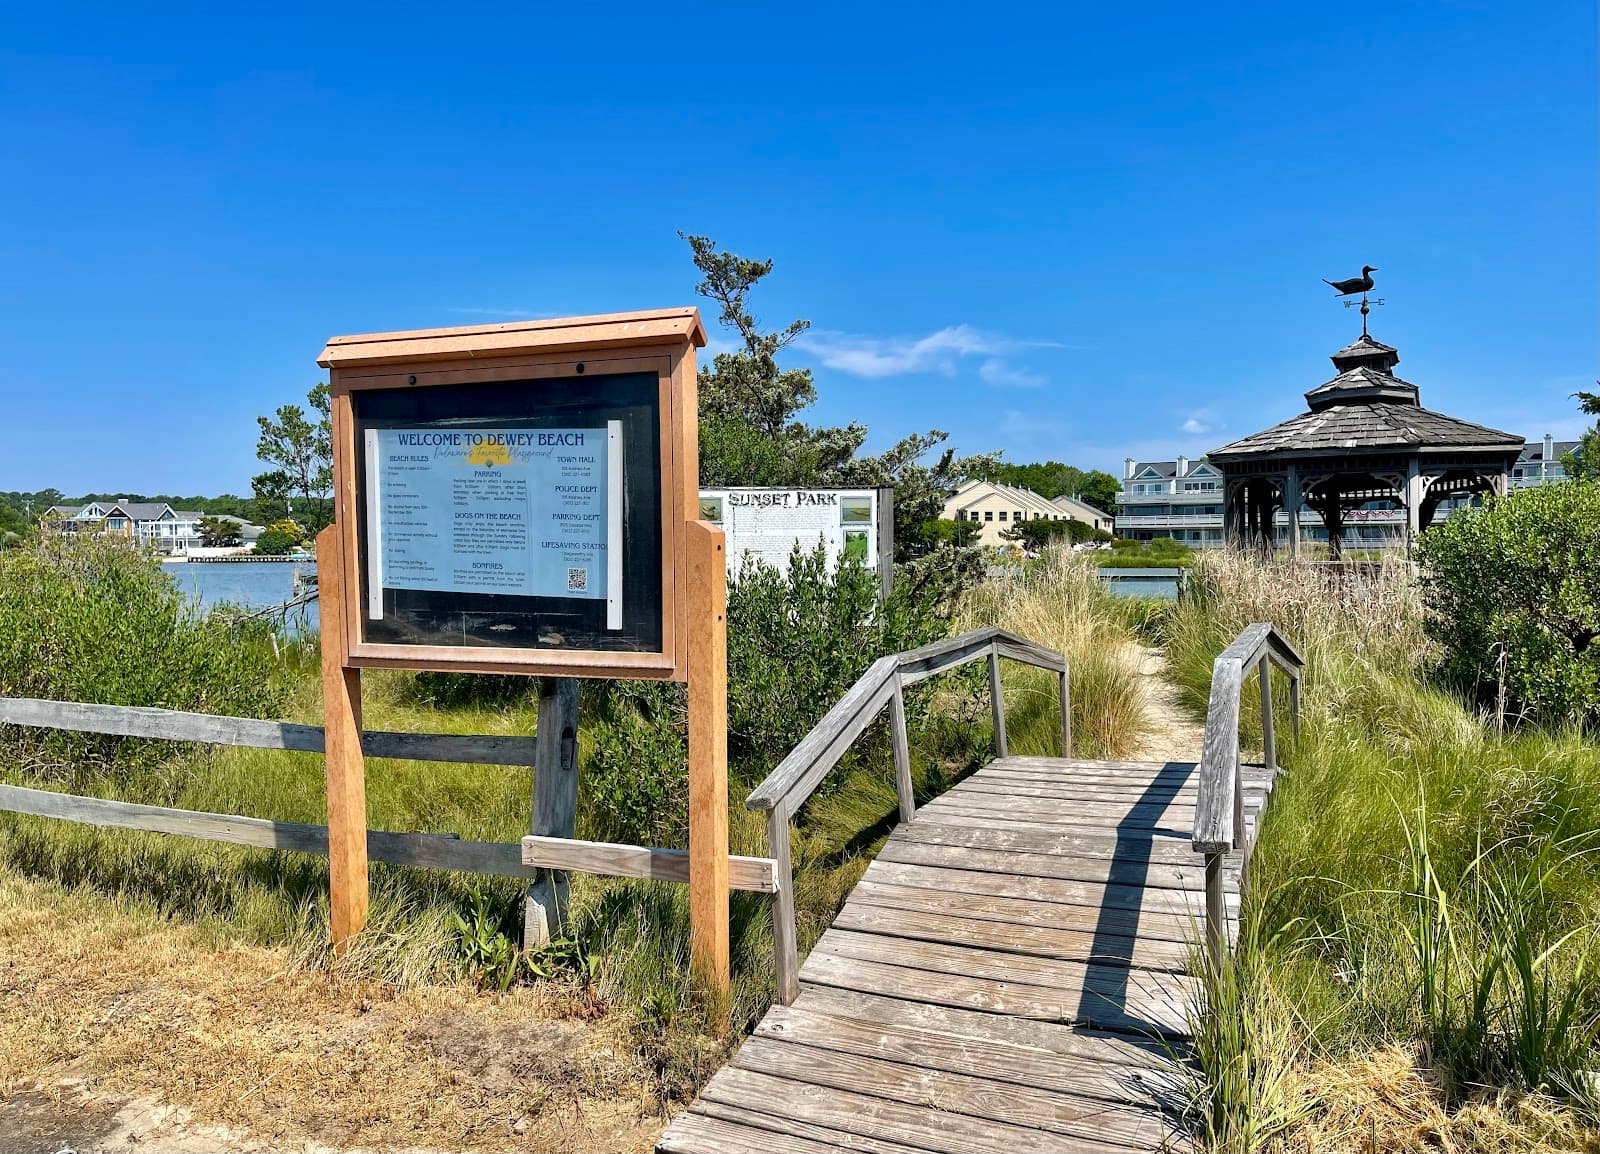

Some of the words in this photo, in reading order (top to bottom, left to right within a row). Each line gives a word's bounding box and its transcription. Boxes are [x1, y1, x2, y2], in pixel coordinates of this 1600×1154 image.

[1343, 300, 1352, 309] W
[1377, 298, 1385, 306] E
[398, 433, 461, 446] WELCOME
[465, 433, 483, 446] TO
[487, 433, 534, 446] DEWEY
[538, 433, 585, 446] BEACH
[578, 456, 596, 464] HALL
[474, 470, 502, 478] PARKING
[555, 485, 579, 493] POLICE
[728, 491, 790, 507] SUNSET
[796, 491, 837, 507] PARK
[455, 512, 473, 520] DOGS
[474, 512, 485, 520] ON
[583, 513, 601, 521] DEPT
[541, 541, 581, 550] LIFESAVING
[582, 543, 608, 551] STATIO
[472, 562, 503, 570] BONFIRES
